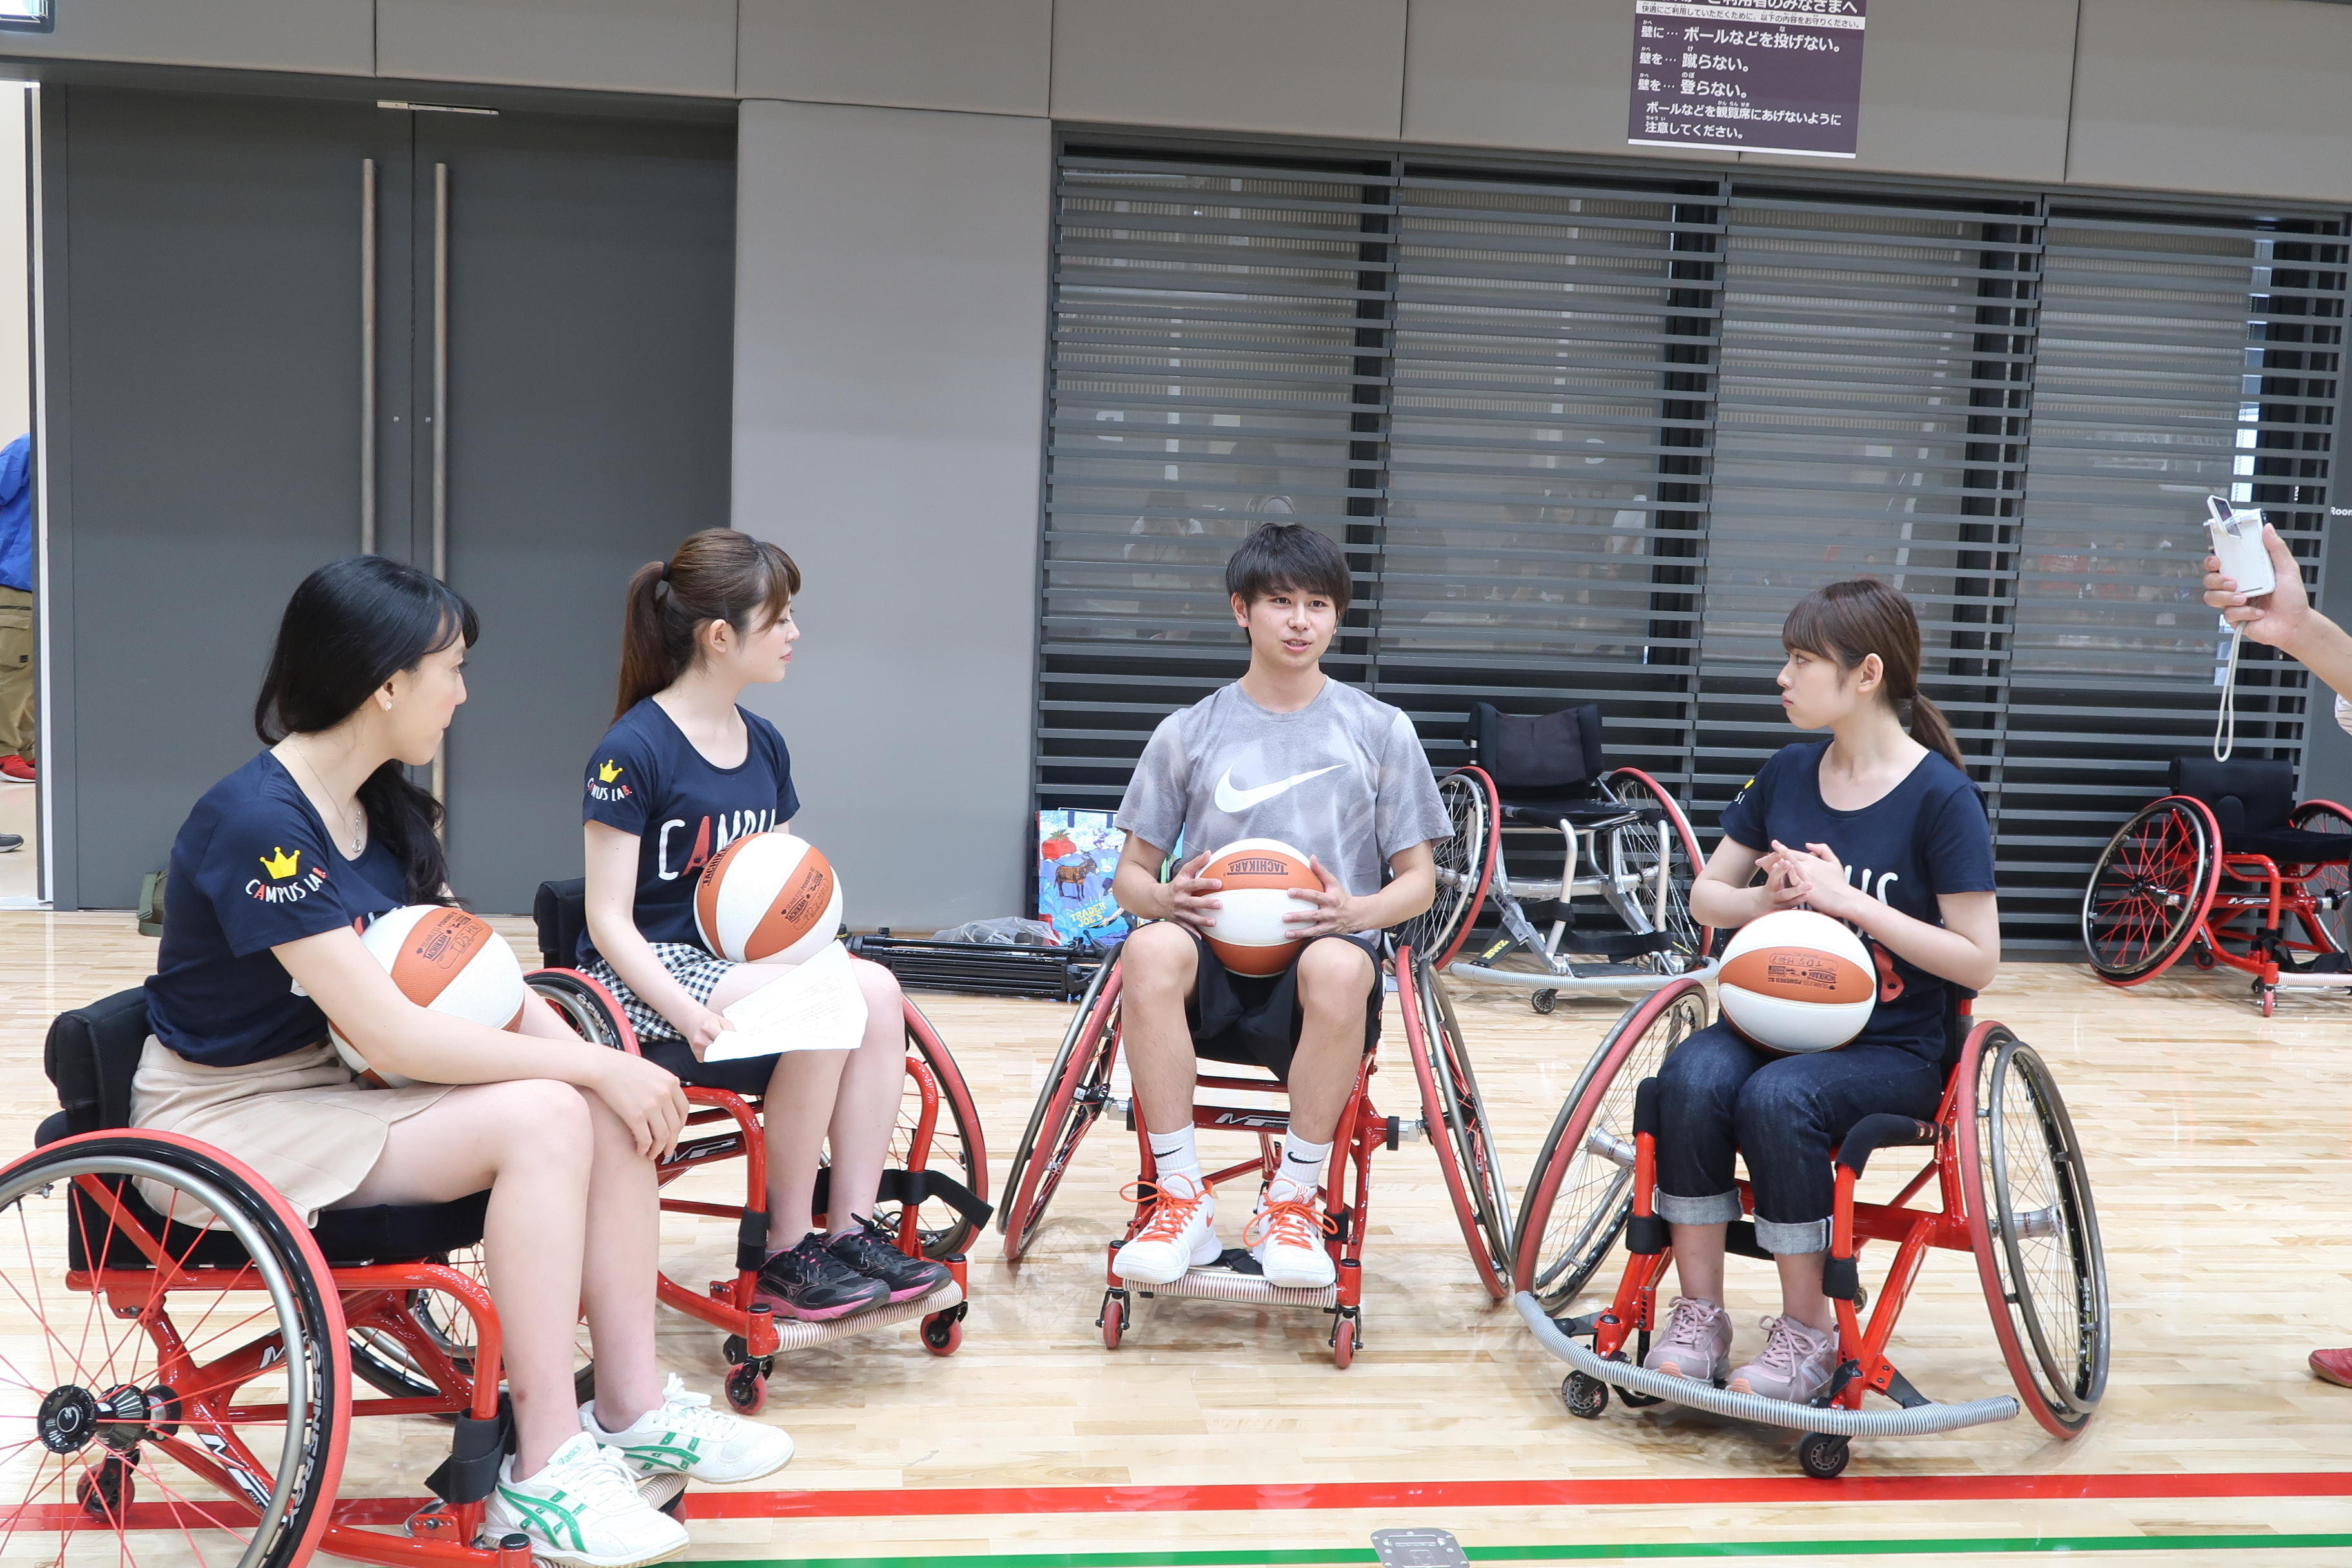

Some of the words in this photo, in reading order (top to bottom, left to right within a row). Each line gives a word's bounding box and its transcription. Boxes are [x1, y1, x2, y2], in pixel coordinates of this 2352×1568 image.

[1683, 26, 1840, 52] ボールなどを投げない。
[1681, 53, 1749, 72] 蹴らない。
[1680, 79, 1747, 98] 登らない。
[1646, 101, 1842, 126] ボールなどを観覧席にあげないように
[1645, 121, 1743, 139] 注意してください。
[1226, 859, 1288, 875] TACHIKARA
[245, 878, 306, 903] CAMPUS
[1070, 902, 1106, 922] TRADER
[1078, 913, 1103, 928] JOE'S
[423, 934, 449, 959] TACHIKARA
